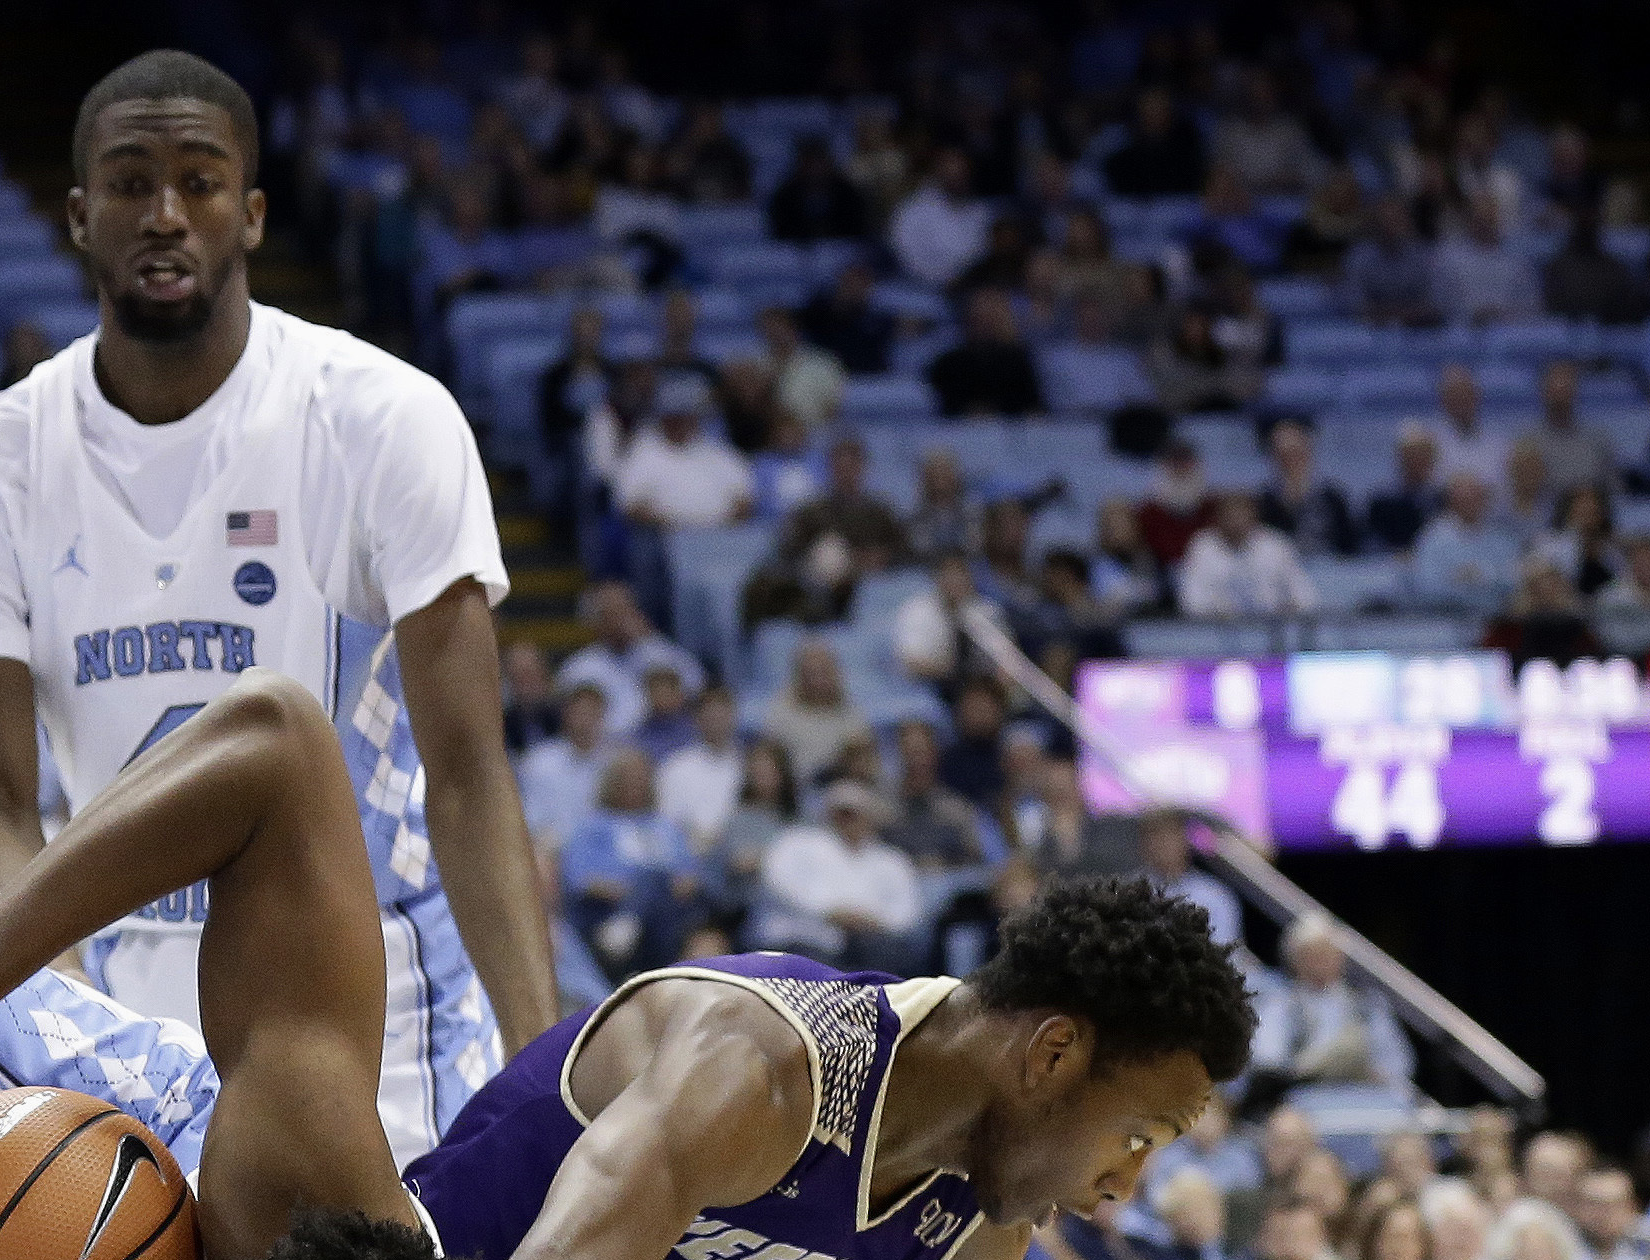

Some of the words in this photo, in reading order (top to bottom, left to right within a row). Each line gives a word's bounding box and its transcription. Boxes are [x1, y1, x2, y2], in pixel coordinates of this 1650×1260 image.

[73, 619, 258, 687] NORTH
[1330, 762, 1447, 851] 44
[1536, 760, 1601, 846] 2
